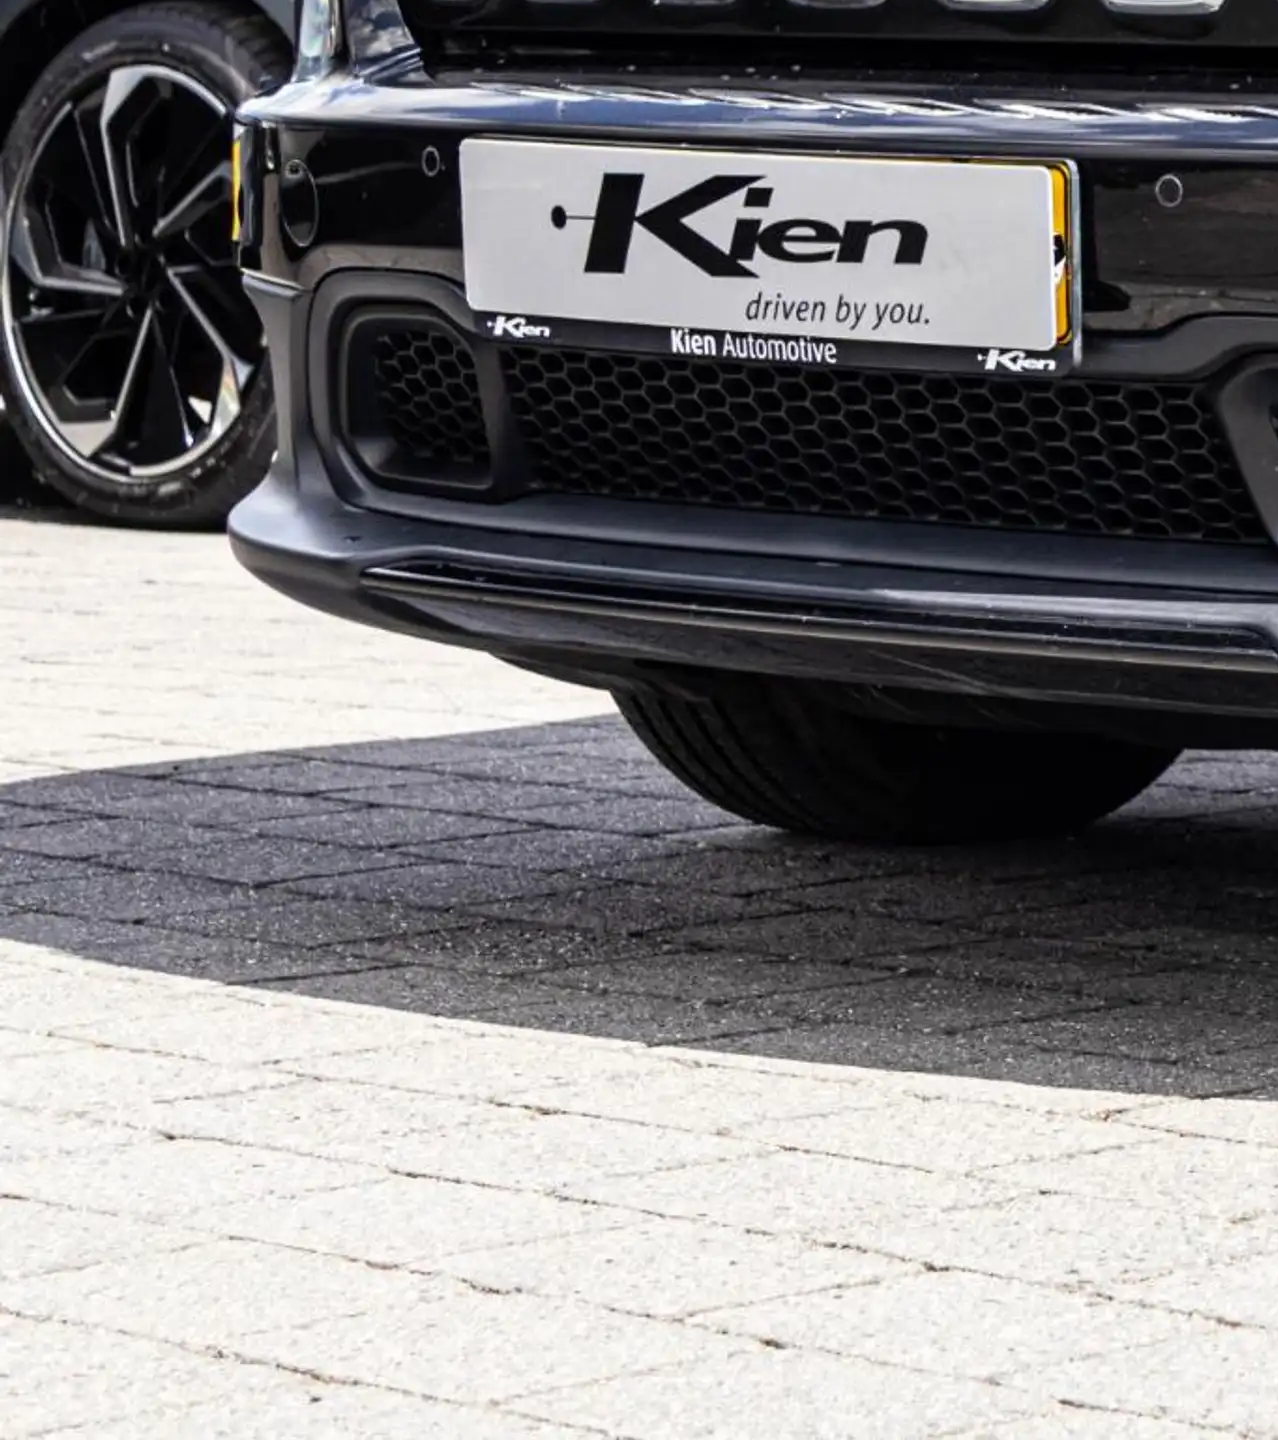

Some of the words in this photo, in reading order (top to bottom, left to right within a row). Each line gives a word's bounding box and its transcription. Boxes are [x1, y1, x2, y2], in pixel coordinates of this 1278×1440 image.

[584, 173, 929, 278] Kien
[493, 315, 550, 338] Kien
[745, 291, 827, 323] driven
[835, 293, 867, 331] by
[871, 302, 931, 331] you.
[670, 327, 717, 356] Kien
[722, 332, 837, 363] Automotive
[985, 348, 1056, 372] Kien
